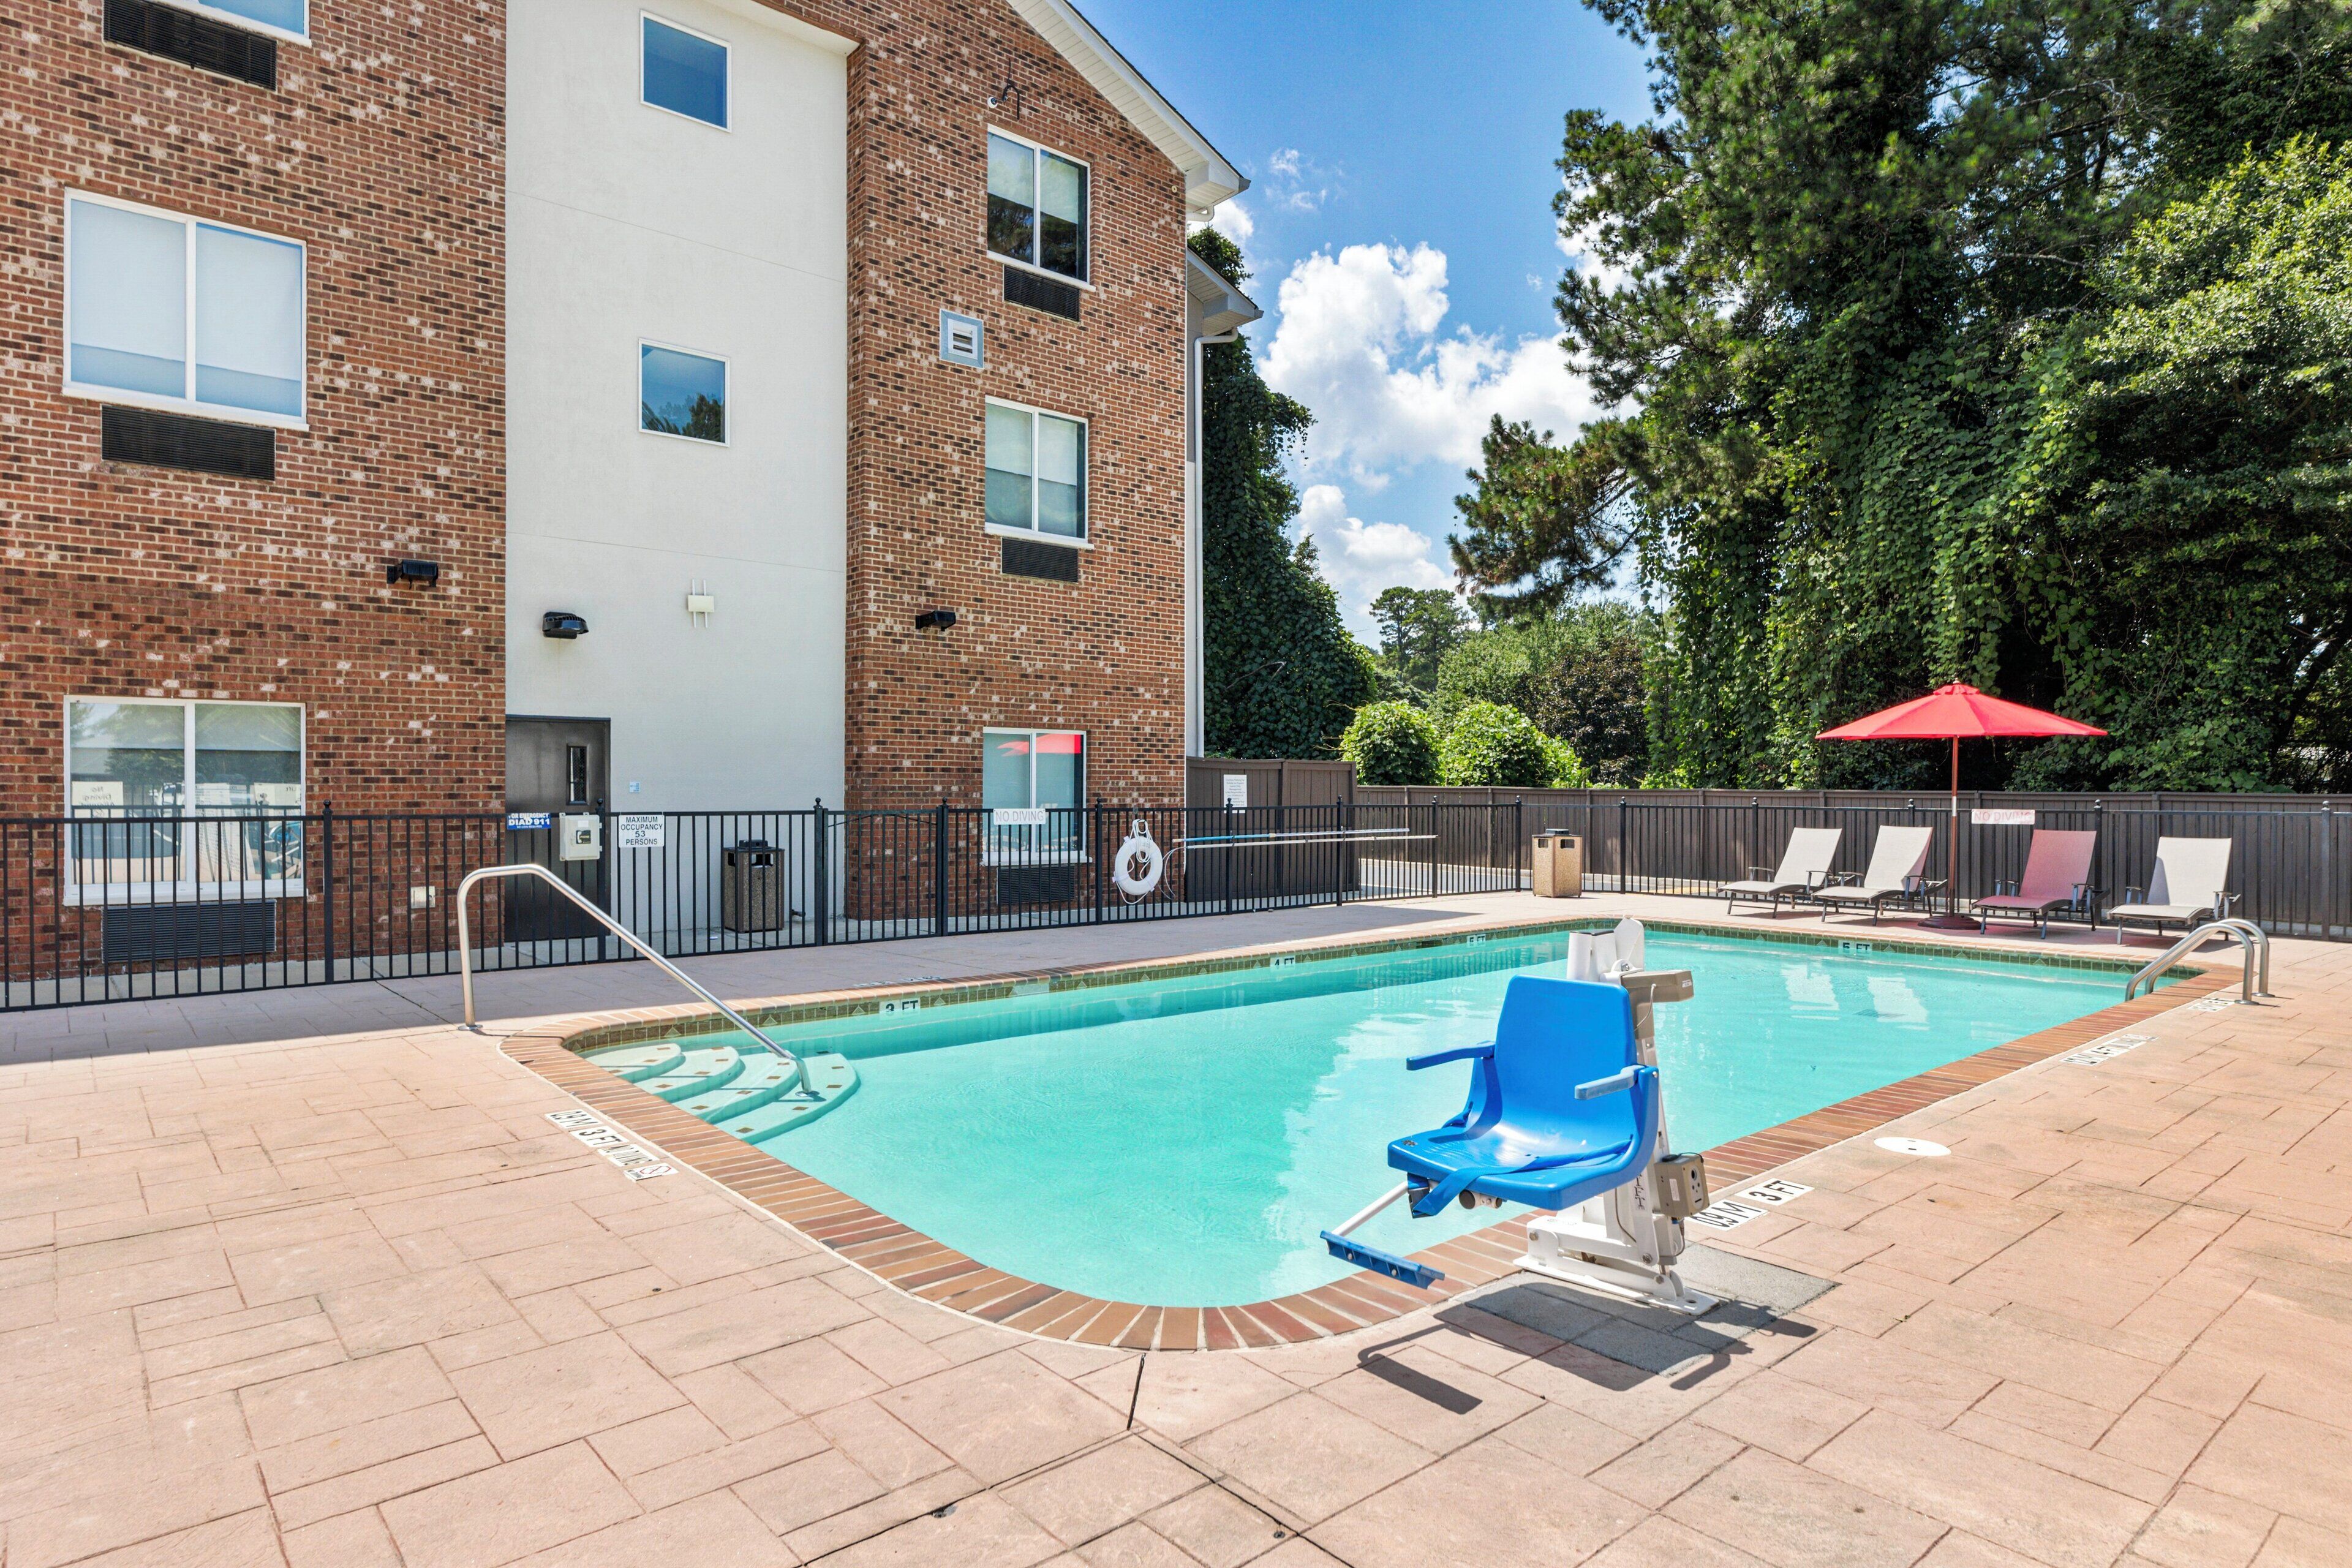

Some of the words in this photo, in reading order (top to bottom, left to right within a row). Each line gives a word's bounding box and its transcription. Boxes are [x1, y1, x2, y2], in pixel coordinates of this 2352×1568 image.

[995, 811, 1009, 821] NO
[1012, 810, 1044, 821] DIVING
[1974, 811, 1990, 821] NO
[587, 1136, 622, 1145] FT
[1763, 1180, 1804, 1194] FT
[1749, 1191, 1782, 1201] 3
[1711, 1201, 1762, 1218] M
[1691, 1212, 1740, 1227] 0.9
